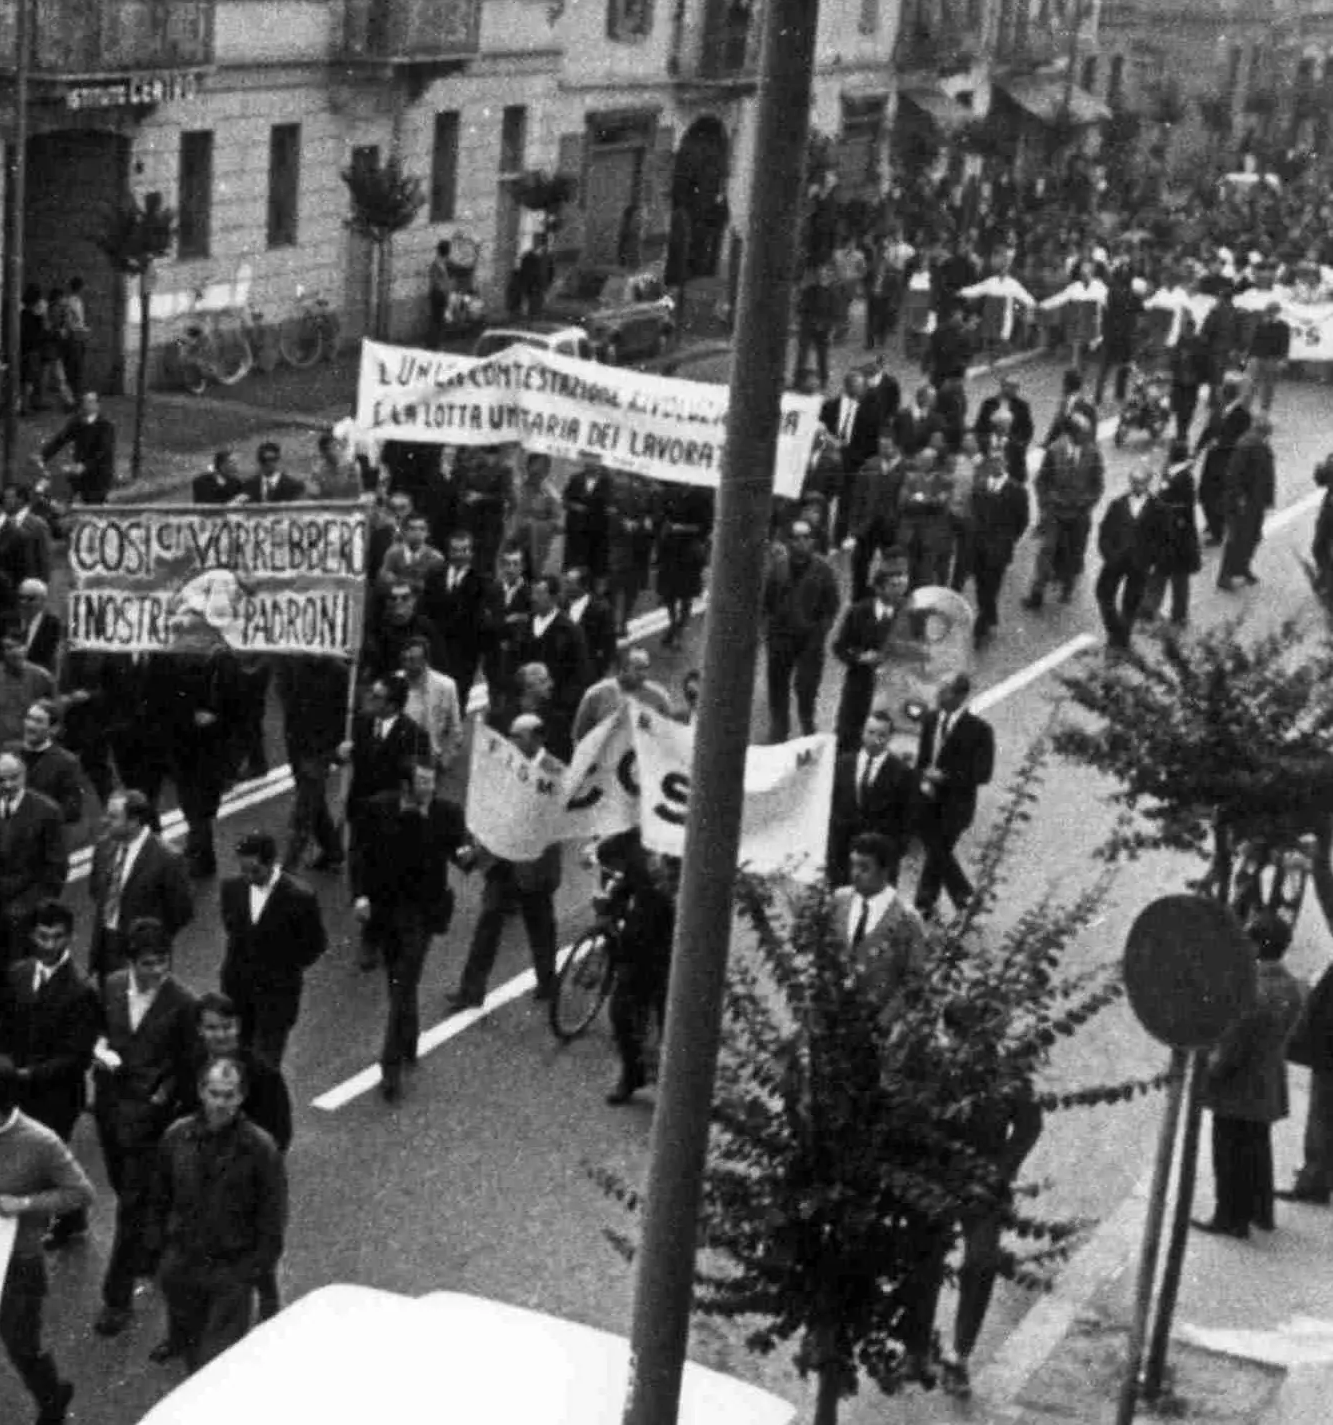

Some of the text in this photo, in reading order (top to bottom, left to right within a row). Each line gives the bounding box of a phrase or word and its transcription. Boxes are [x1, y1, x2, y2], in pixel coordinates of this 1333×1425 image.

[425, 401, 482, 430] LOTTA
[188, 520, 366, 573] VORREBBERO
[240, 595, 349, 648] PADRONI
